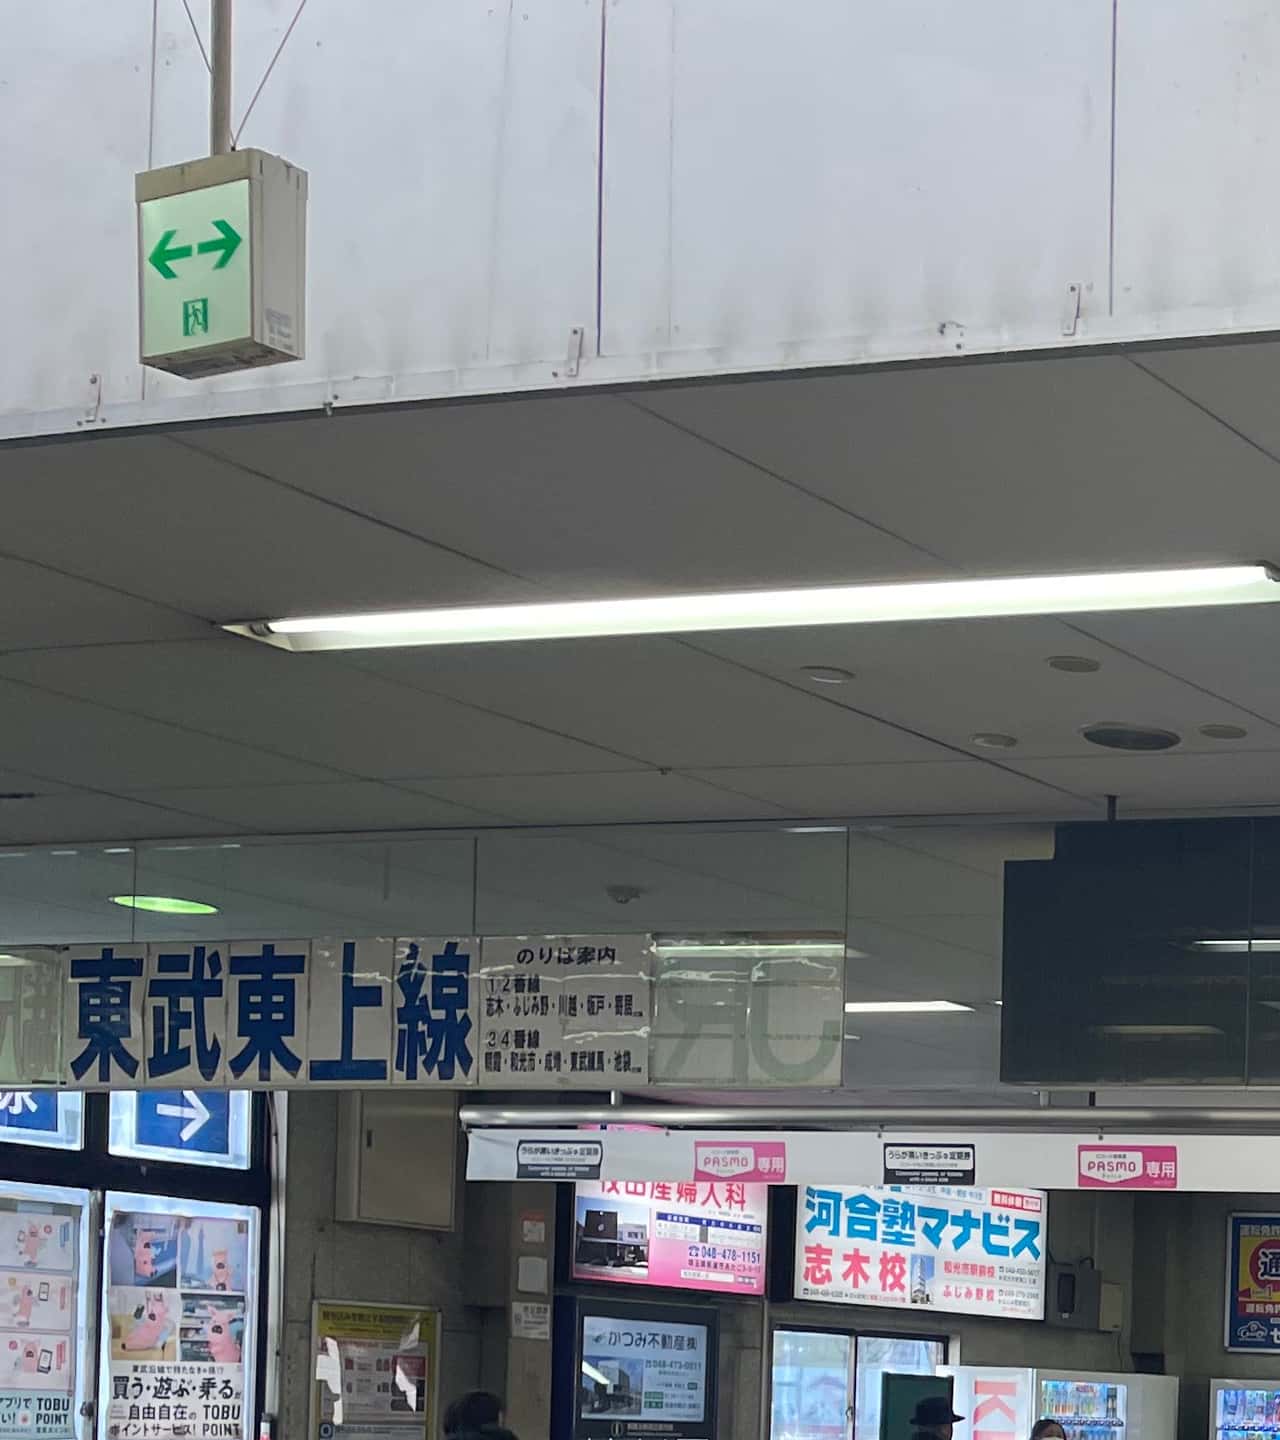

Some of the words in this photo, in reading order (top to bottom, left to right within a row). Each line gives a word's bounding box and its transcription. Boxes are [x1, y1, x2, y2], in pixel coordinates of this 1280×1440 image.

[516, 946, 617, 964] のりば案内
[70, 941, 473, 1082] 東武東上線
[703, 1156, 749, 1167] PASMO
[1087, 1161, 1136, 1172] PASMO
[1145, 1161, 1176, 1178] 専用
[805, 1186, 1041, 1261] 河合塾マナビス
[803, 1243, 906, 1293] 志木校
[37, 1398, 70, 1411] TOBU
[36, 1414, 68, 1425] POINT
[204, 1405, 241, 1420] TOBU
[203, 1424, 241, 1436] POINT
